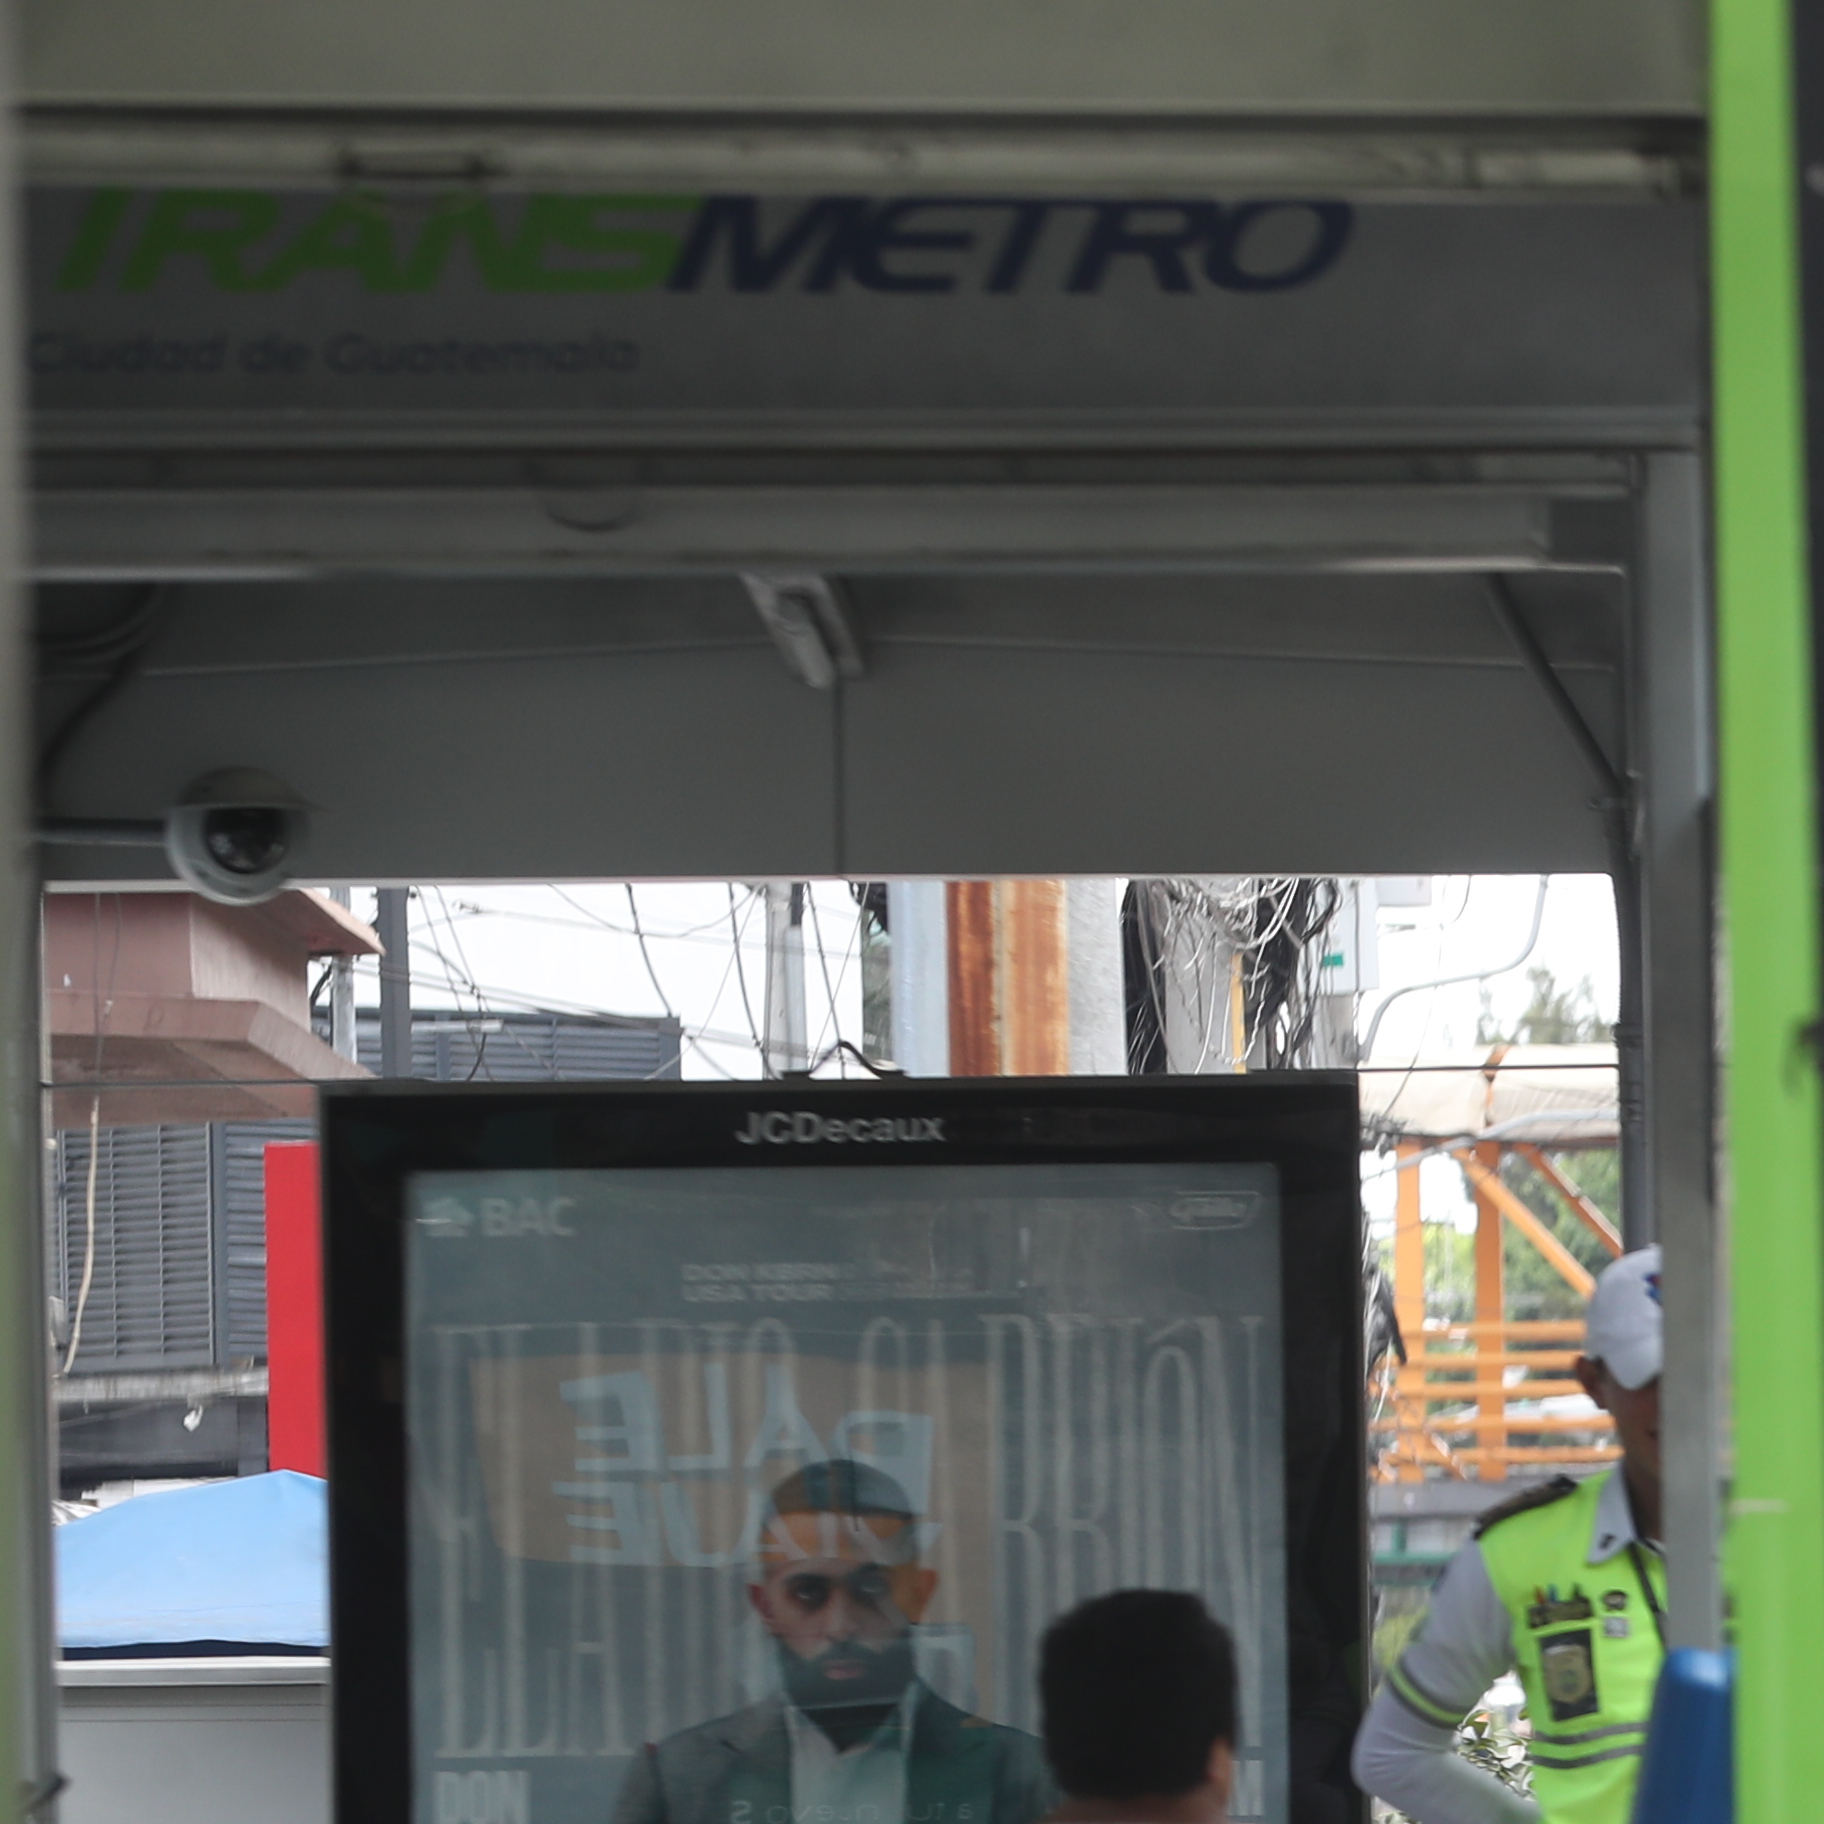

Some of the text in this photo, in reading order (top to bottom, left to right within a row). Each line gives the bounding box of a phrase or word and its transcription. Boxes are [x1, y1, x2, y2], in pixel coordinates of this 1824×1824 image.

[30, 331, 640, 377] Ciudad de Guatemala
[734, 1110, 945, 1147] JCDecaux
[479, 1197, 578, 1238] BAC
